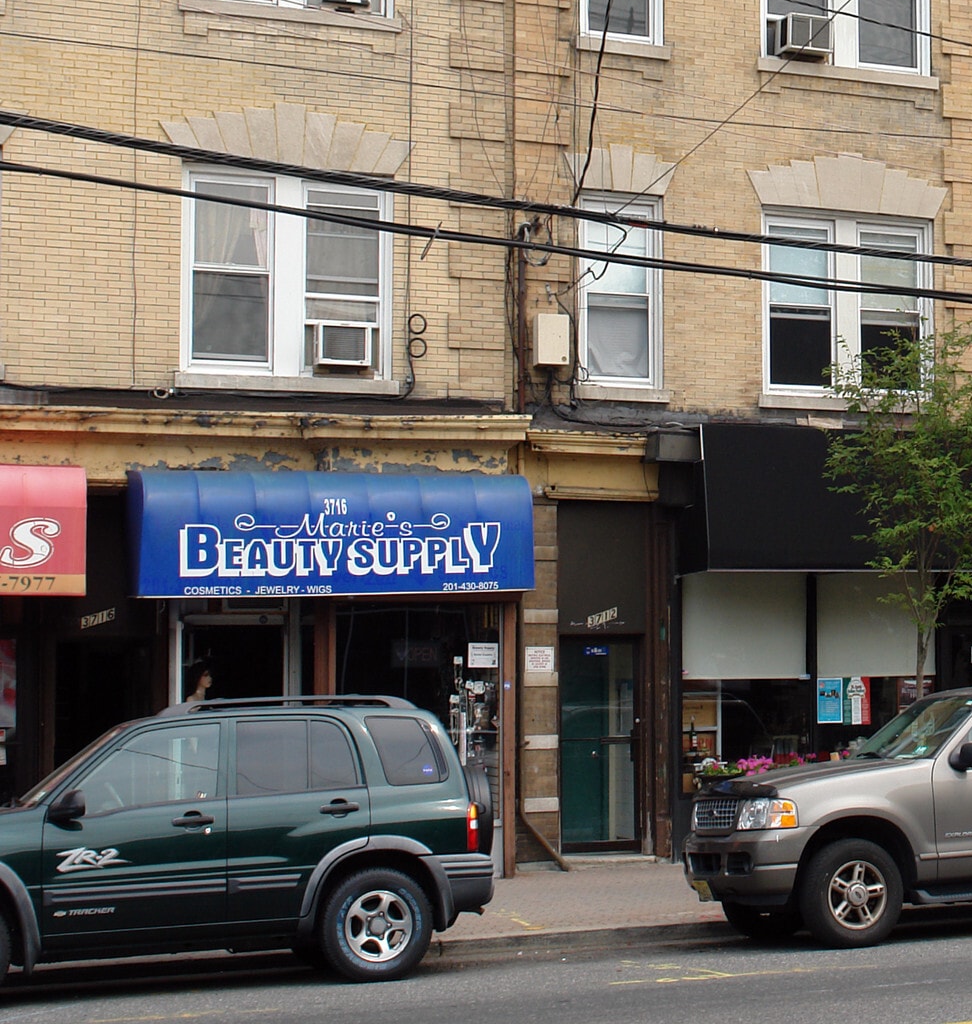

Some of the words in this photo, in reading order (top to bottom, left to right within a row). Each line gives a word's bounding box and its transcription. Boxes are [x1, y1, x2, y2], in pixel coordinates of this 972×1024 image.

[323, 498, 347, 515] 3716
[275, 512, 413, 538] Marie's
[179, 524, 343, 577] BEAUTY
[347, 522, 501, 575] SUPPLY
[0, 576, 56, 592] -7977
[184, 586, 242, 595] COSMETICS
[255, 585, 300, 595] JEWELRY
[307, 585, 332, 594] WIGS
[443, 581, 499, 592] 201-430-8075
[81, 609, 115, 628] 3716
[588, 608, 617, 626] 3712
[56, 846, 132, 873] ZR-2
[68, 907, 116, 916] TRACKER
